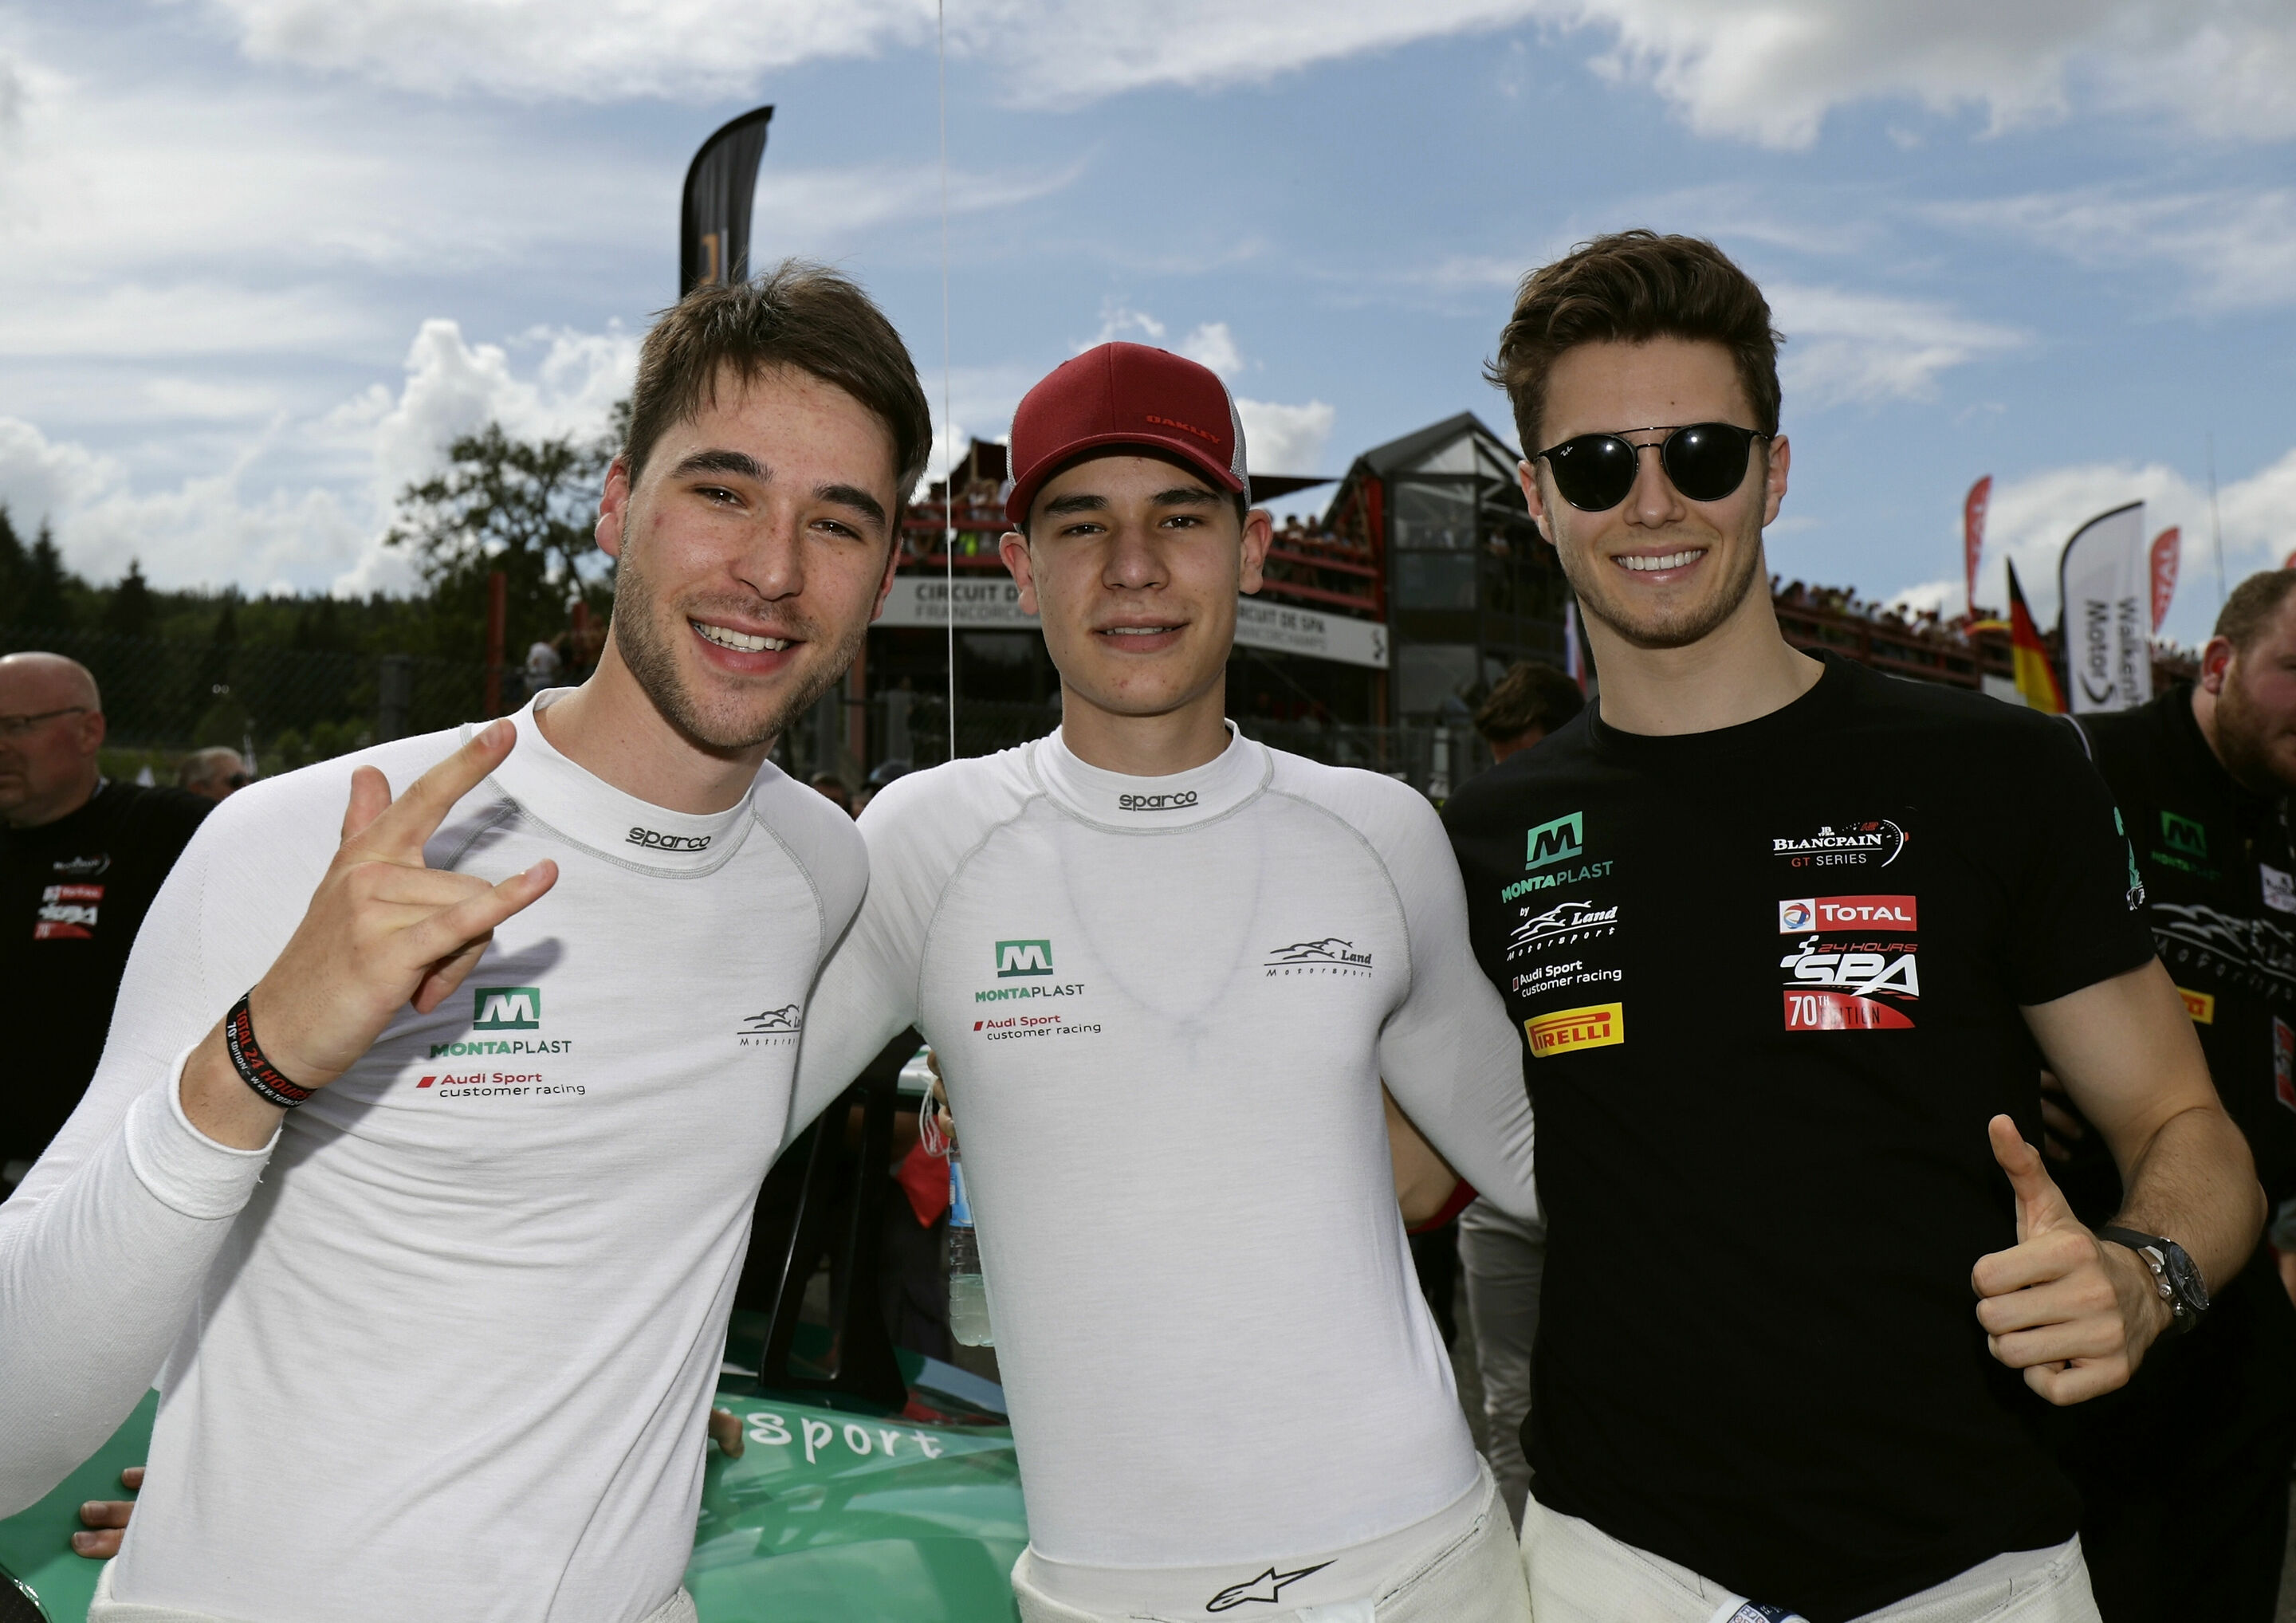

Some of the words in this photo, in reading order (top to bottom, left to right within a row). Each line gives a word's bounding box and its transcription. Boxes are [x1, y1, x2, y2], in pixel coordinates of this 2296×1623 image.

[1146, 415, 1221, 444] OAKLEY
[915, 583, 997, 602] CIRCUIT
[1005, 584, 1020, 602] D
[1237, 603, 1277, 623] RCUIT
[1300, 616, 1326, 634] SPA
[1119, 790, 1197, 812] sparco
[627, 827, 712, 850] sparco
[1773, 834, 1882, 851] BLANCPAIN
[1791, 857, 1810, 867] GT
[1816, 854, 1867, 866] SERIES
[1501, 861, 1614, 903] MONTAPLAST
[1520, 906, 1530, 917] by
[1571, 906, 1618, 925] Land
[1819, 904, 1912, 922] TOTAL
[1507, 926, 1615, 961] Motorsport
[1818, 943, 1847, 953] 24
[1850, 942, 1919, 953] HOURS
[1341, 949, 1372, 964] Land
[1266, 968, 1372, 978] Motorsport
[1520, 969, 1542, 985] Audi
[1545, 960, 1582, 978] Sport
[1791, 953, 1920, 996] SPA
[1521, 975, 1573, 997] customer
[1576, 969, 1622, 984] racing
[975, 984, 1085, 1003] MONTAPLAST
[986, 1018, 1016, 1028] Audi
[1020, 1015, 1061, 1027] Sport
[236, 1008, 252, 1048] TOTAL
[244, 1047, 265, 1069] 24
[987, 1028, 1052, 1040] customer
[1057, 1024, 1101, 1033] racing
[1528, 1012, 1611, 1051] PIRELLI
[231, 1041, 248, 1070] EDITION
[430, 1040, 572, 1059] MONTAPLAST
[441, 1073, 486, 1085] Audi
[492, 1072, 542, 1086] Sport
[439, 1087, 530, 1098] customer
[536, 1083, 586, 1095] racing
[745, 1412, 943, 1465] sport
